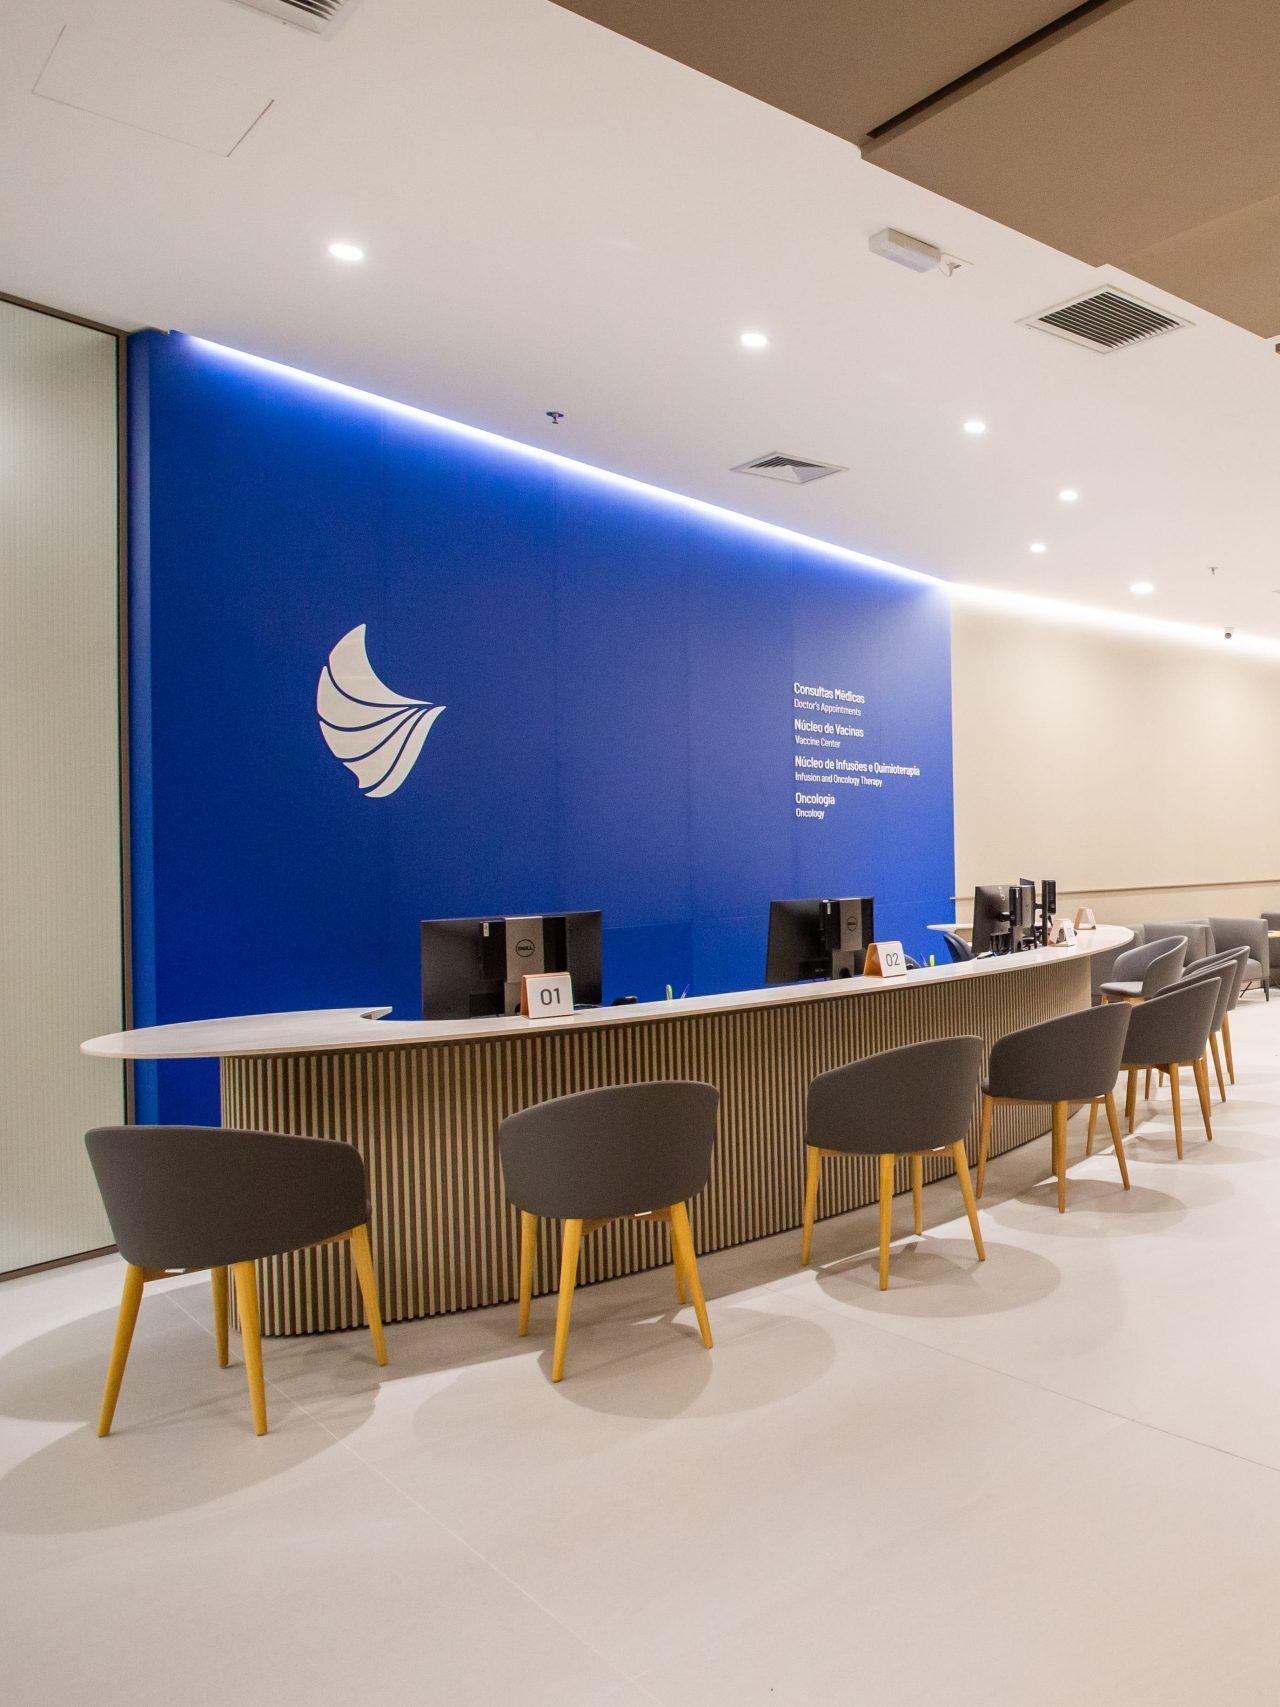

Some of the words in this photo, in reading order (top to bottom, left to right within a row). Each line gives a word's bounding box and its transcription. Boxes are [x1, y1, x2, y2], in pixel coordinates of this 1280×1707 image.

[794, 682, 834, 700] Consultas
[835, 688, 865, 704] Médicas
[794, 698, 820, 711] Doctor's
[821, 703, 861, 716] Appointments
[794, 718, 823, 733] Núcleo
[824, 722, 834, 734] de
[835, 724, 864, 738] Vacinas
[795, 734, 820, 747] Vaccine
[820, 737, 841, 749] Center
[795, 755, 823, 769] Núcleo
[824, 758, 835, 770] de
[836, 759, 868, 773] Infusões
[868, 763, 874, 773] e
[874, 762, 920, 778] Quimioterapia
[795, 771, 821, 783] Infusion
[821, 773, 833, 784] and
[833, 774, 860, 787] Oncology
[861, 775, 883, 788] Therapy
[795, 792, 836, 807] Oncologia
[796, 808, 825, 820] Oncology
[885, 952, 900, 967] 02
[540, 987, 561, 1006] 01
